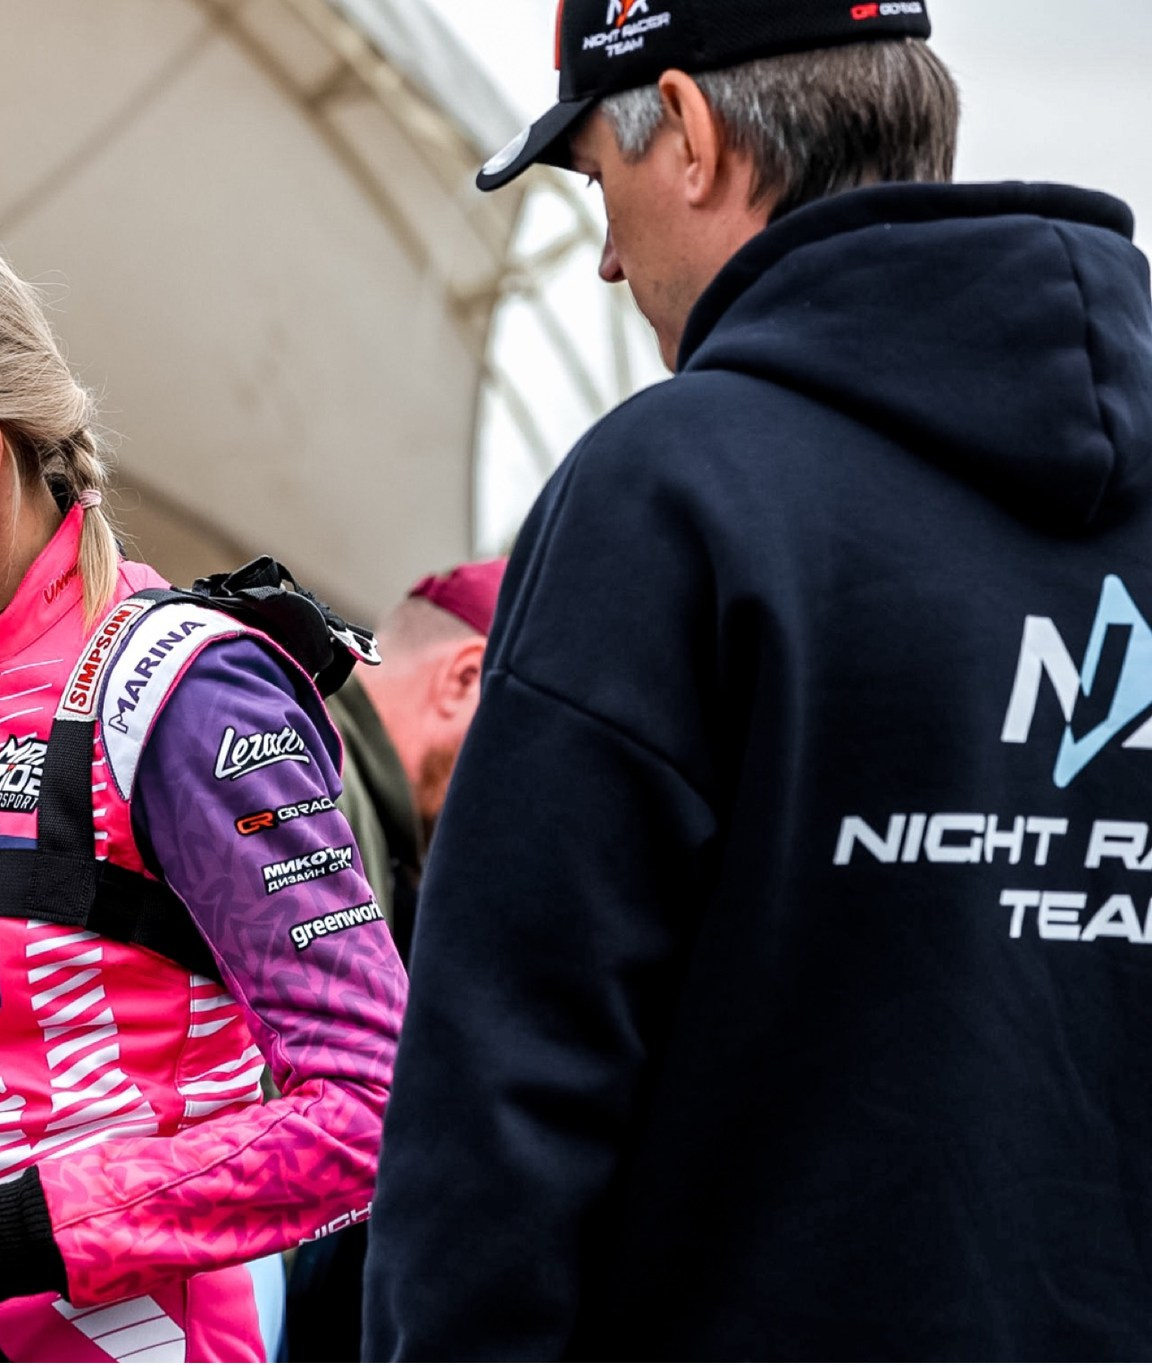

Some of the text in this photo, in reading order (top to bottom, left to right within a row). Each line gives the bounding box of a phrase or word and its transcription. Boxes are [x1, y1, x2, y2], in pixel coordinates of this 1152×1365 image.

[69, 608, 132, 708] SIMPSON
[108, 618, 206, 734] MARINA
[833, 813, 1069, 866] NIGHT
[268, 867, 325, 893] ДИЗАЙН
[1000, 889, 1152, 943] TEA
